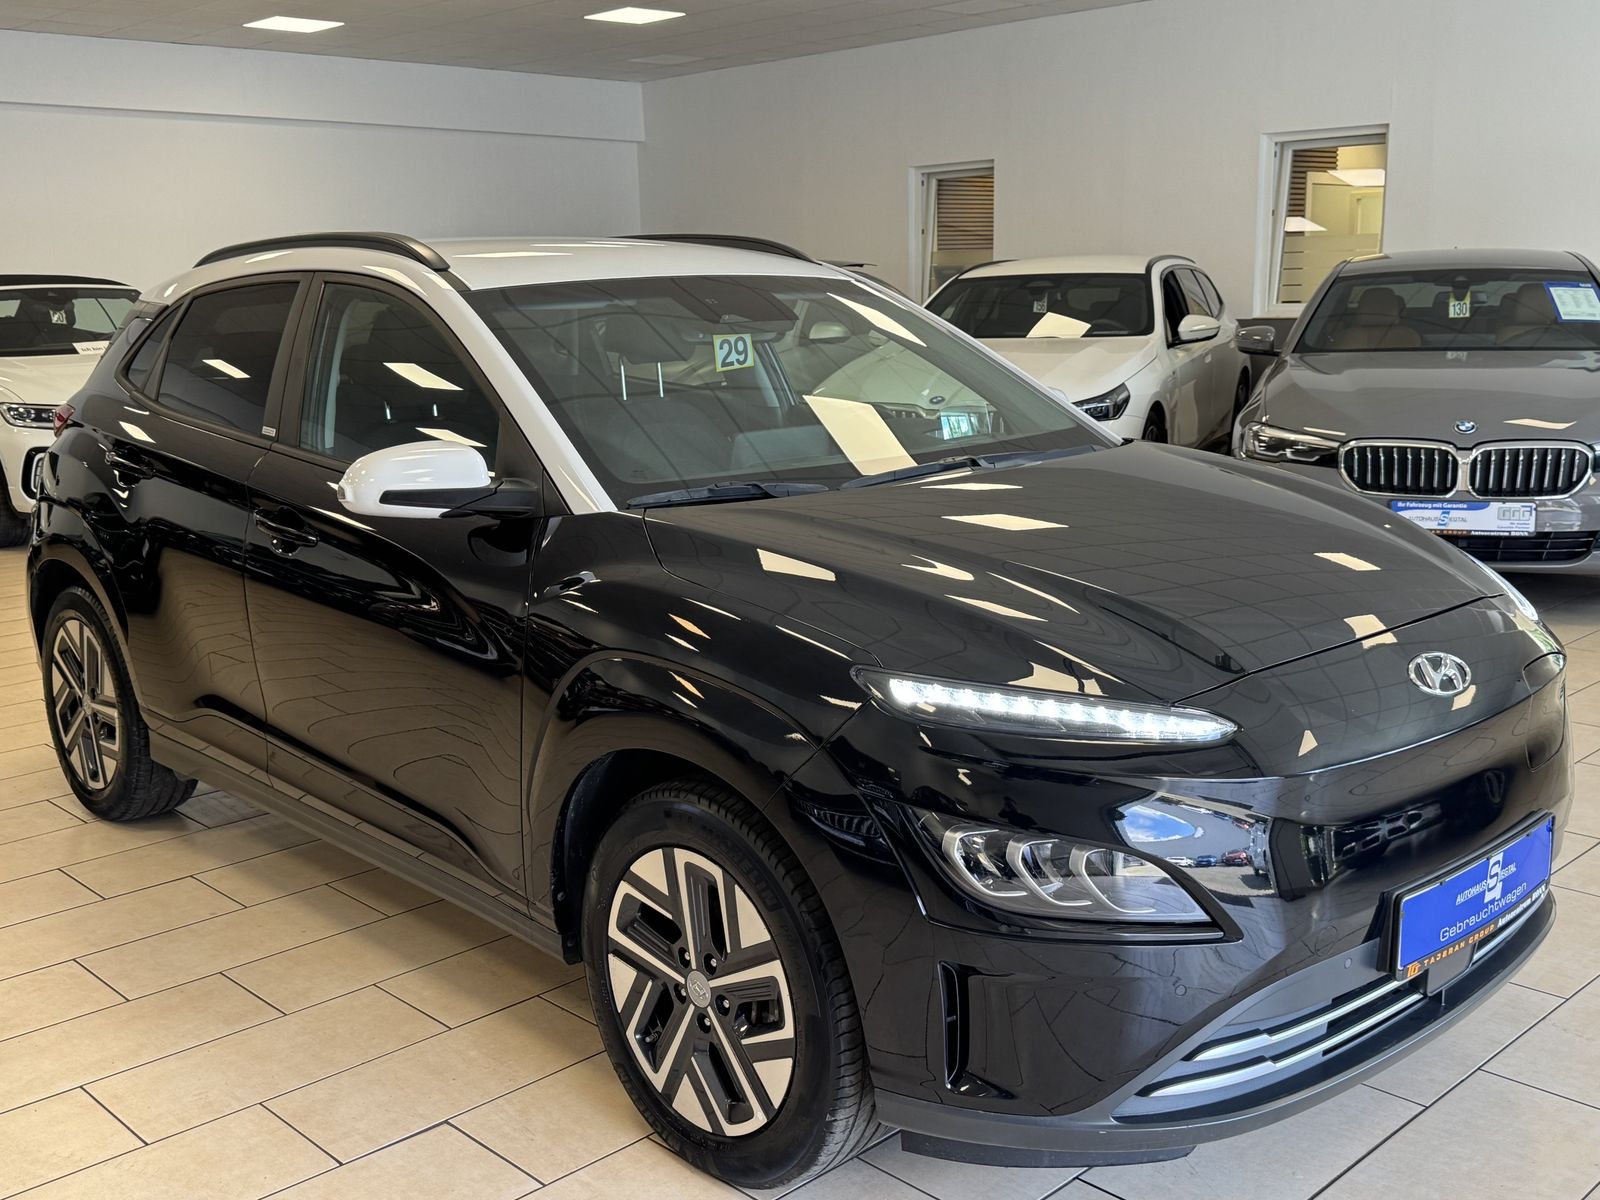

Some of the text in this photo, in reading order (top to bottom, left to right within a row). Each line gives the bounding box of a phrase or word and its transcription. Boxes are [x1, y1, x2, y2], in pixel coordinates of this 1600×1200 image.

[1452, 303, 1467, 316] 130
[719, 336, 748, 368] 29
[1456, 880, 1488, 905] AUTOHAUS
[1440, 882, 1527, 942] Gebrauchtwagen
[1468, 924, 1495, 944] GROUP
